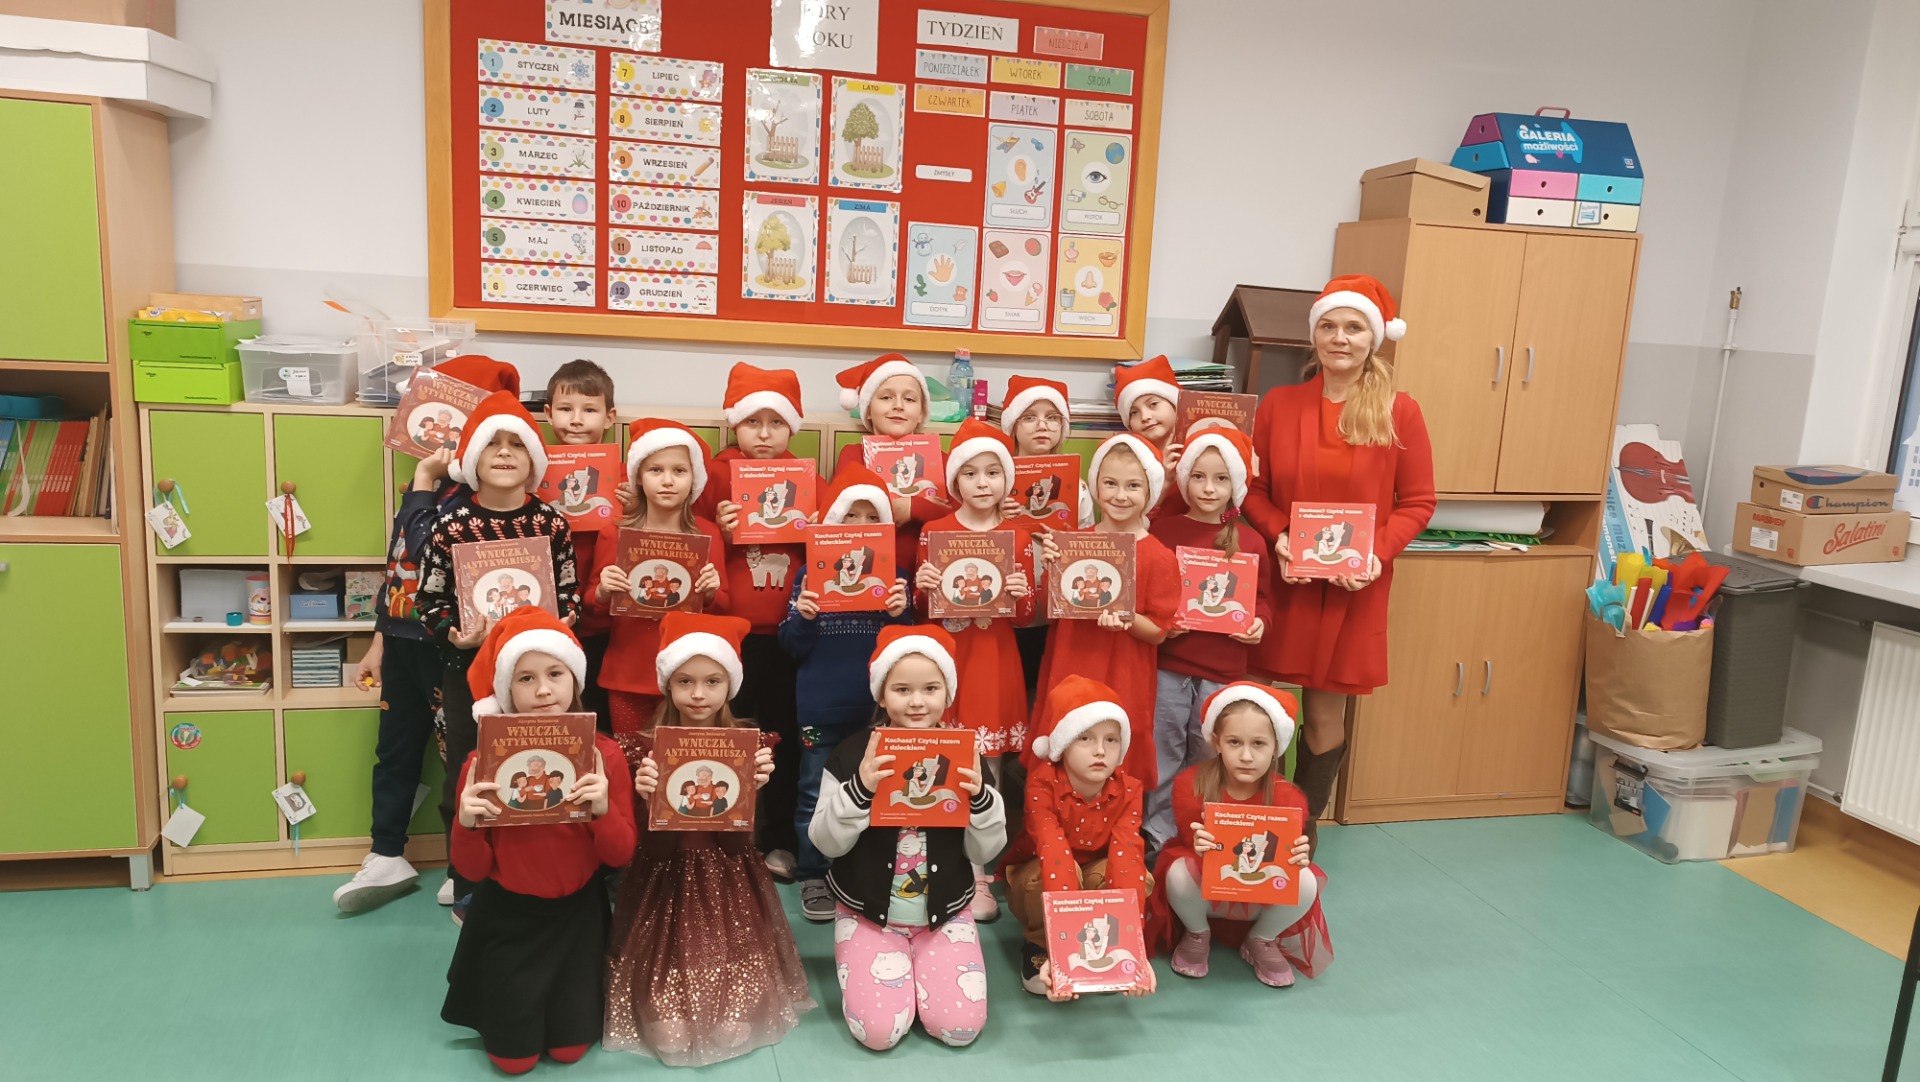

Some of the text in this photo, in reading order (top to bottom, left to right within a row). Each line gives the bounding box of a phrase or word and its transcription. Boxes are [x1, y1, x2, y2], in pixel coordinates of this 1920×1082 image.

[927, 20, 1004, 41] TYDZIEŃ
[812, 31, 853, 49] OKU
[1049, 38, 1089, 51] NIEDZIELA
[491, 58, 560, 72] 1 STYCZEŃ
[924, 62, 980, 78] PONIEDZIAŁEK
[622, 69, 680, 82] 7 LIPIEC
[1009, 67, 1042, 80] WTOREK
[928, 94, 972, 108] CZWARTEK
[490, 104, 550, 116] 2 LUTY
[1084, 110, 1114, 121] SOBOTA
[619, 115, 684, 129] 8 SIERPIEŃ
[1519, 128, 1576, 143] GALERIA
[1523, 141, 1579, 152] możliwości
[491, 148, 558, 160] 3 MARZEC
[619, 155, 688, 169] 9 WRZESIEŃ
[491, 196, 561, 208] 4 KWIECIEŃ
[617, 200, 691, 213] 10 PAŹDZIERNIK
[492, 233, 549, 245] 5 MAJ
[617, 243, 684, 254] 11 LISTOPAD
[492, 282, 563, 293] 6 CZERWIEC
[615, 287, 683, 298] 12 GRUDZIEŃ
[417, 385, 477, 411] ANTYKWARIUS
[1196, 399, 1239, 410] WNUCZKA
[1186, 407, 1247, 417] ANTYKWARIUSZA
[1806, 495, 1889, 513] Champion
[947, 539, 995, 548] WNUCZKA
[1823, 520, 1888, 555] Salatini
[640, 538, 689, 551] WNUCZKA
[1068, 540, 1116, 550] WNUCZKA
[476, 547, 530, 560] WNUCZKA
[627, 546, 699, 560] ANTYKWARIUSZA
[937, 547, 1006, 556] ANTYKWARIUSZA
[466, 555, 542, 569] ANTYKWARIUSZA
[506, 725, 570, 737] WNUCZKA
[491, 736, 584, 747] ANTYKWARIUSZA
[678, 737, 735, 749] WNUCZKA
[917, 737, 939, 745] Czytaj
[664, 748, 747, 758] ANTYKWARIUSZA
[1214, 811, 1245, 820] Kochasz?
[1246, 813, 1267, 822] Czytaj
